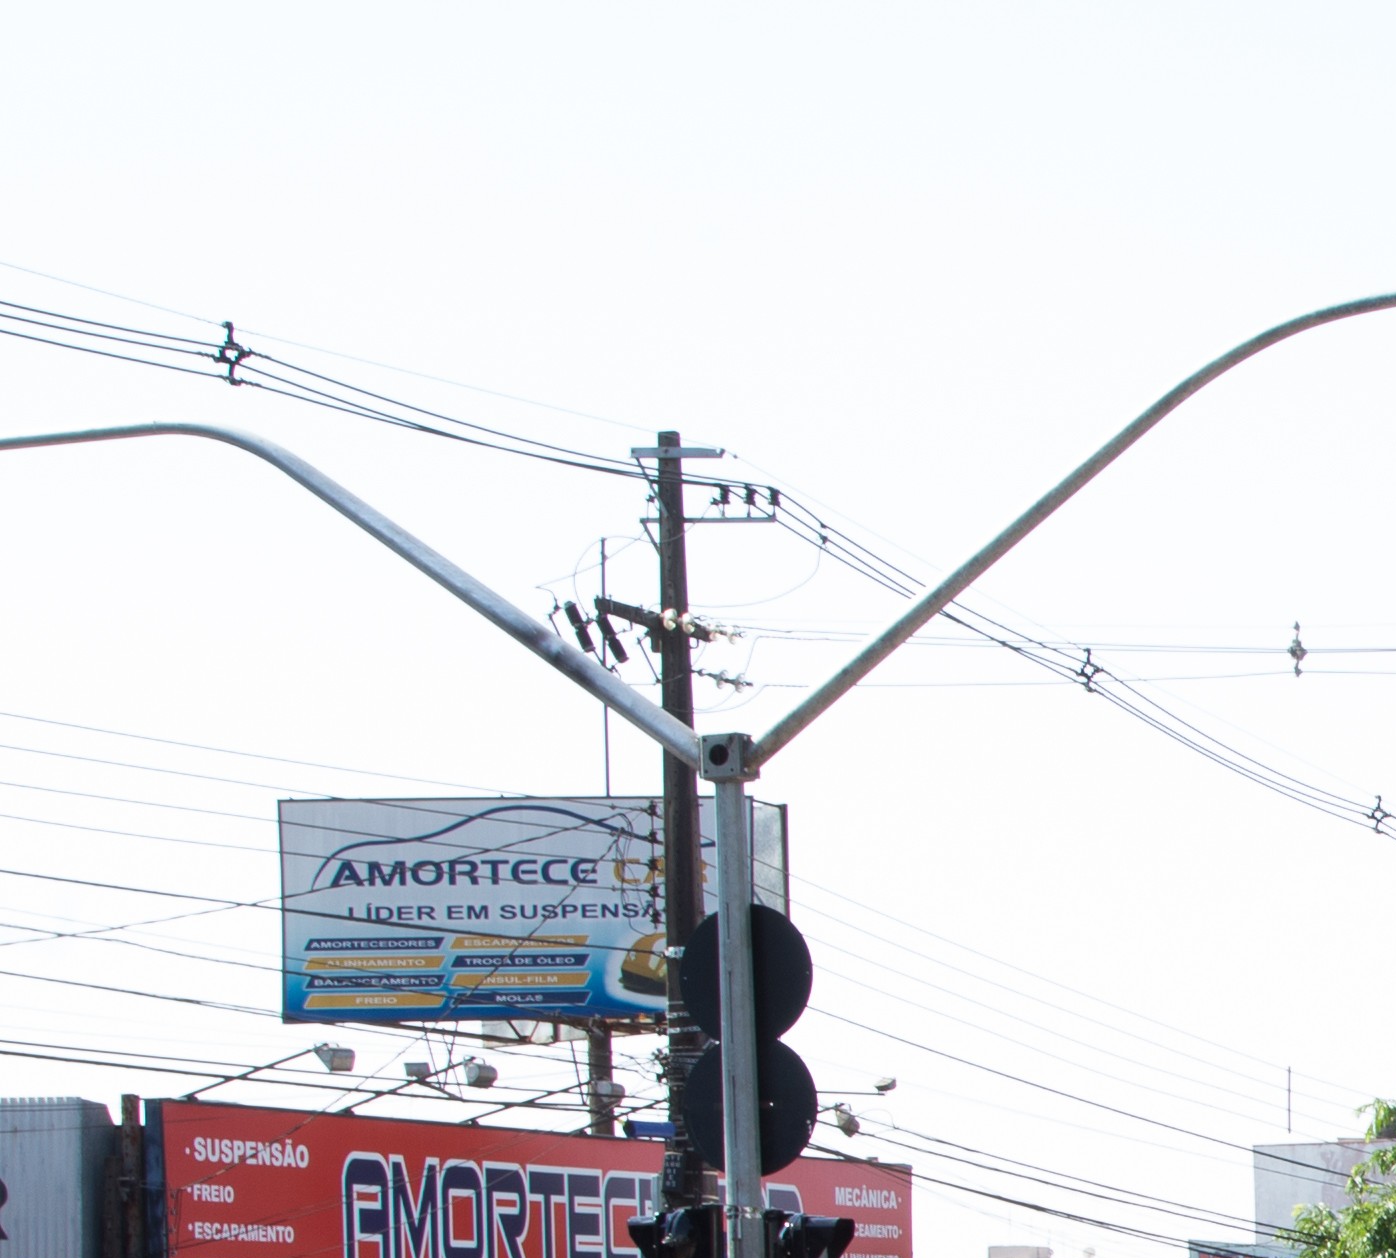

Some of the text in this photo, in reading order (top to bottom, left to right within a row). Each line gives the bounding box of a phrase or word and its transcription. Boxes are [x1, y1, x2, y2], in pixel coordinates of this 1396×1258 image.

[330, 859, 598, 887] AMORTECE
[348, 899, 665, 922] LÍDER EM SUSPENSÃ
[310, 939, 436, 949] AMORTECEDORES
[327, 958, 426, 967] ALINHAMENTO
[464, 955, 575, 965] TROCA DE ÓLEO
[355, 996, 397, 1004] FREIO
[496, 994, 543, 1003] MOLAS
[194, 1137, 309, 1168] SUSPENSÃO
[193, 1184, 234, 1203] FREIO
[835, 1185, 898, 1210] MECÂNICA
[194, 1222, 294, 1243] ESCAPAMENTO
